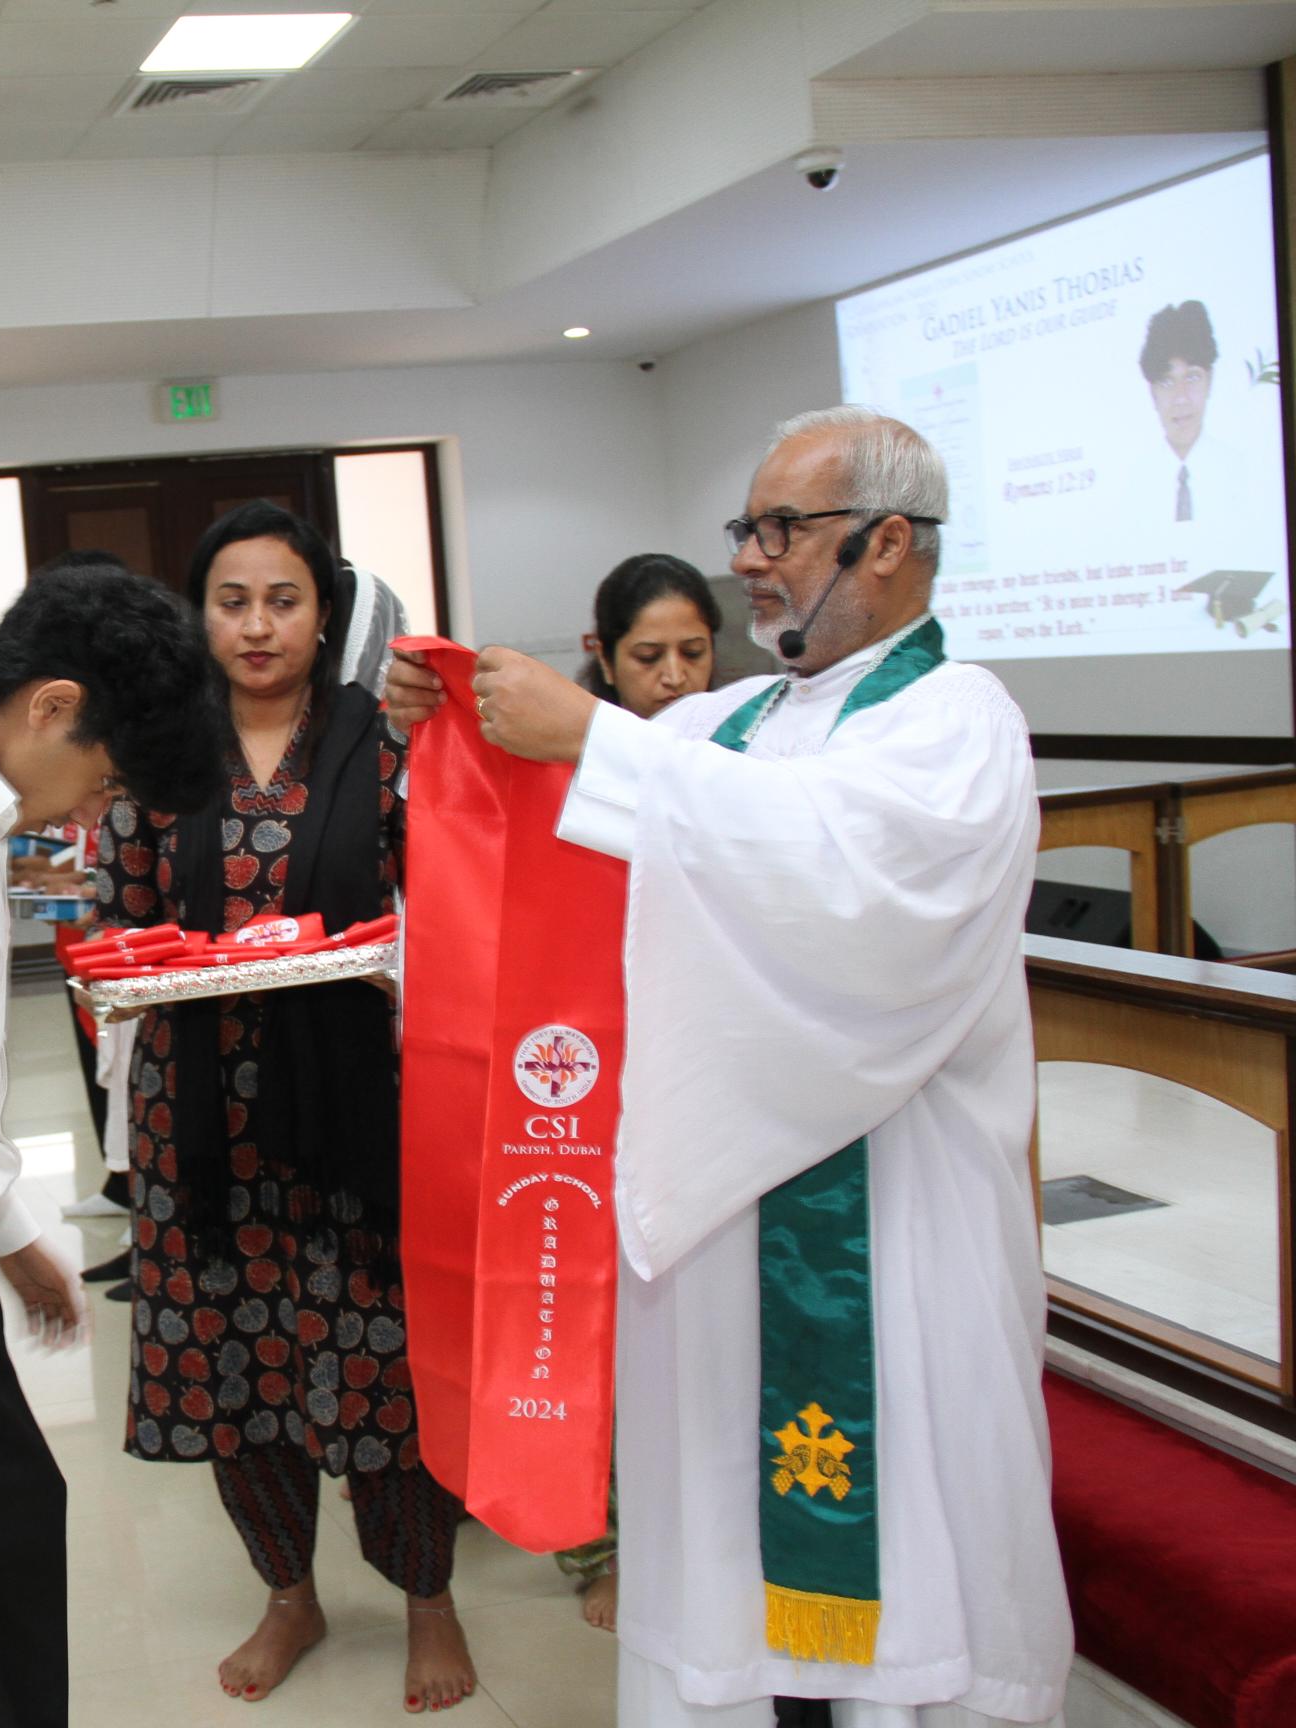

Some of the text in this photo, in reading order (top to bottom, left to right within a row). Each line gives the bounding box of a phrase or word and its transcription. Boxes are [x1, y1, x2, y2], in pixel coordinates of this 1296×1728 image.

[169, 384, 213, 419] EXIT
[525, 1115, 580, 1139] CSI
[497, 1173, 602, 1210] SUNDAY SCHOOL
[508, 1397, 567, 1420] 2024
